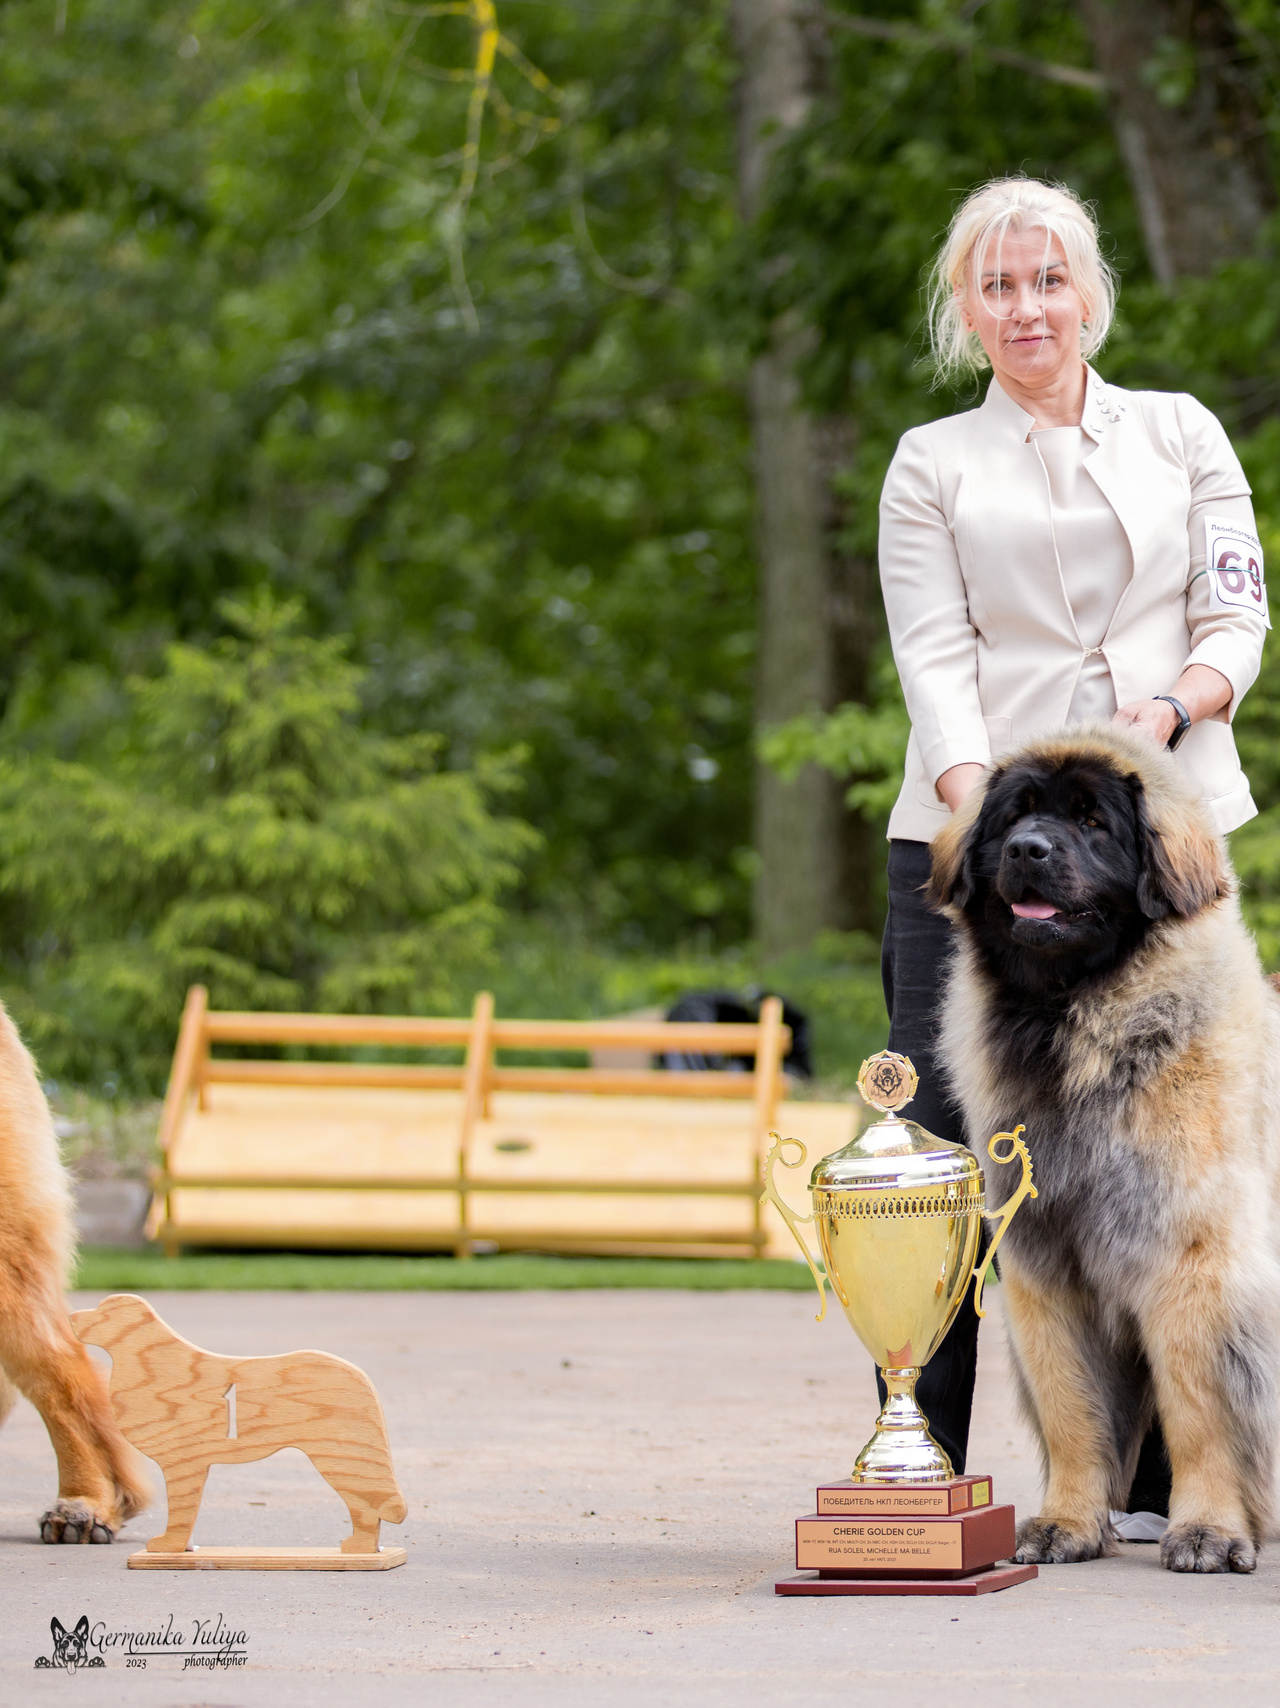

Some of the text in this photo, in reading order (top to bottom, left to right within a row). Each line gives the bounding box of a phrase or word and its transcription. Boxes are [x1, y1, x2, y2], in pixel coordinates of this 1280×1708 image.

[1217, 550, 1262, 603] 69
[222, 1383, 238, 1439] 1
[823, 1497, 874, 1506] ПОБЕДИТЕЛЬ
[876, 1498, 891, 1506] НКП
[893, 1498, 943, 1506] ЛЕОНБЕРГЕР
[833, 1527, 926, 1536] CHERIE GOLDEN CUP
